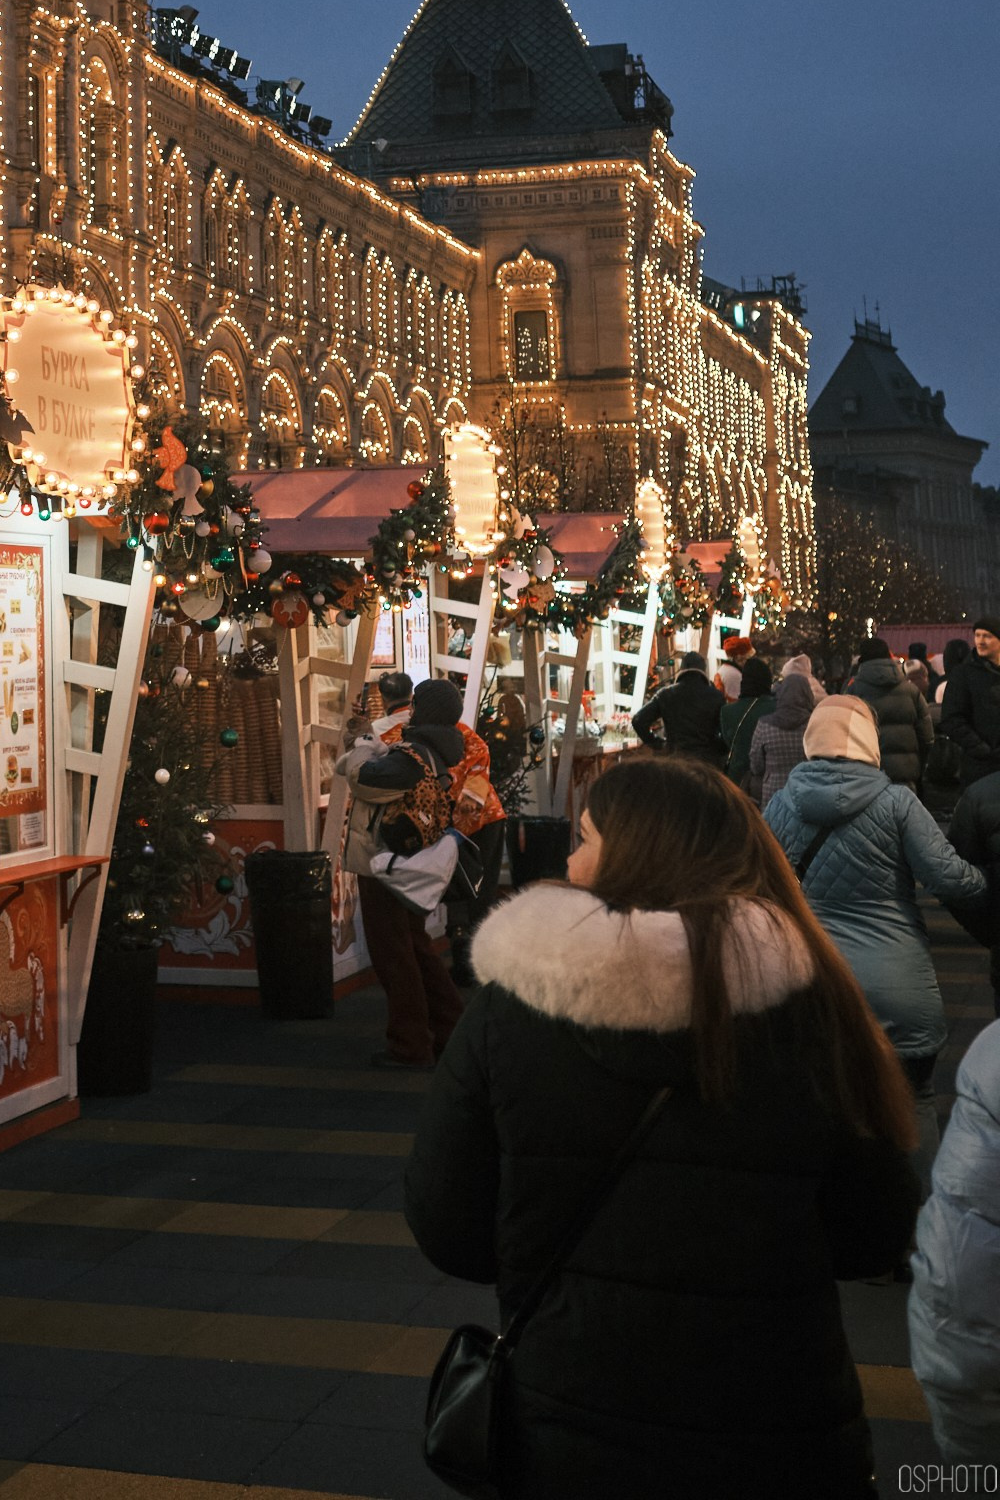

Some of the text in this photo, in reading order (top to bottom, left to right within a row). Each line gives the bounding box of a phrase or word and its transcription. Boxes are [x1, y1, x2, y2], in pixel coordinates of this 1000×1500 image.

[41, 345, 90, 393] БУРКА
[38, 395, 96, 443] В БУЛКЕ
